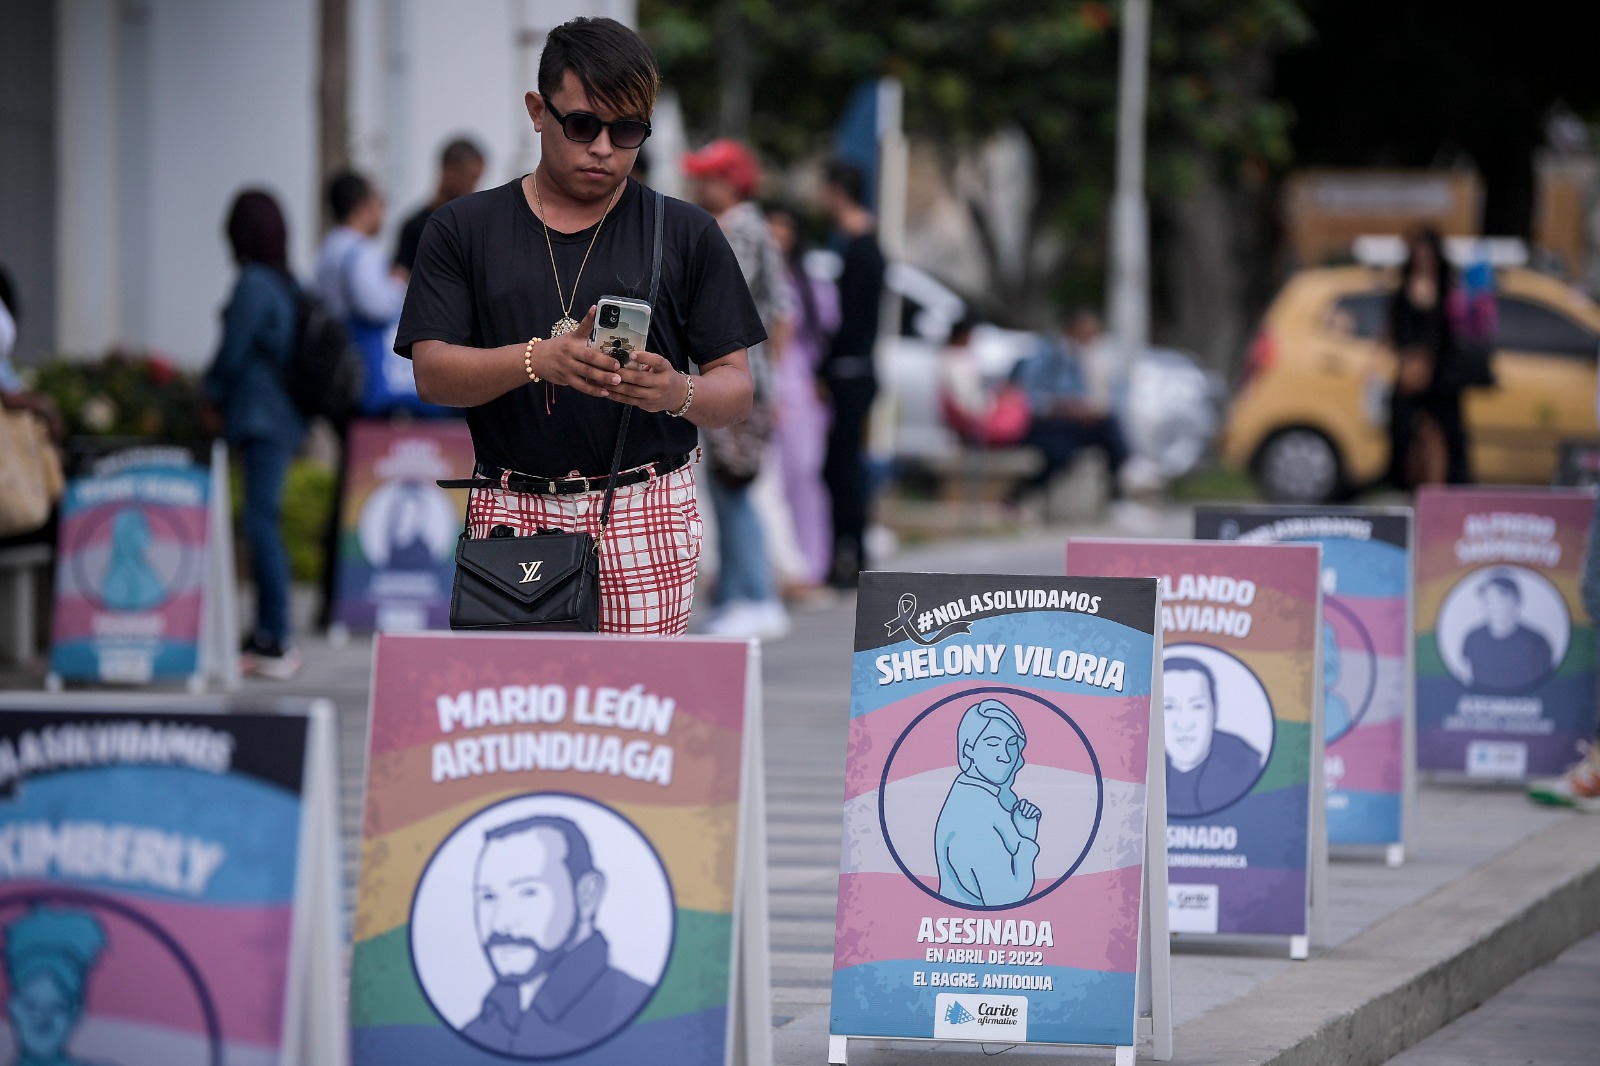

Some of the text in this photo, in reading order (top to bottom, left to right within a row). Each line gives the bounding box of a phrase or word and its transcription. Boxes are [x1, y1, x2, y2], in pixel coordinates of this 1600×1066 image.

[1162, 574, 1257, 608] LANDO
[917, 589, 1102, 633] #NOLASOLVIDAMOS
[1162, 604, 1253, 639] AVIANO
[875, 644, 1126, 692] SHELONY VILORIA
[436, 684, 675, 735] MARIO LEÓN
[432, 731, 674, 786] ARTUNDUAGA
[1167, 825, 1238, 850] SINADO
[917, 917, 1054, 947] ASESINADA
[925, 947, 1043, 967] EN ABRIL DE 2022
[913, 971, 1054, 991] EL BAGRE, ANTIOQUIA
[977, 1002, 1019, 1017] Caribe
[977, 1016, 1018, 1026] afirmativo
